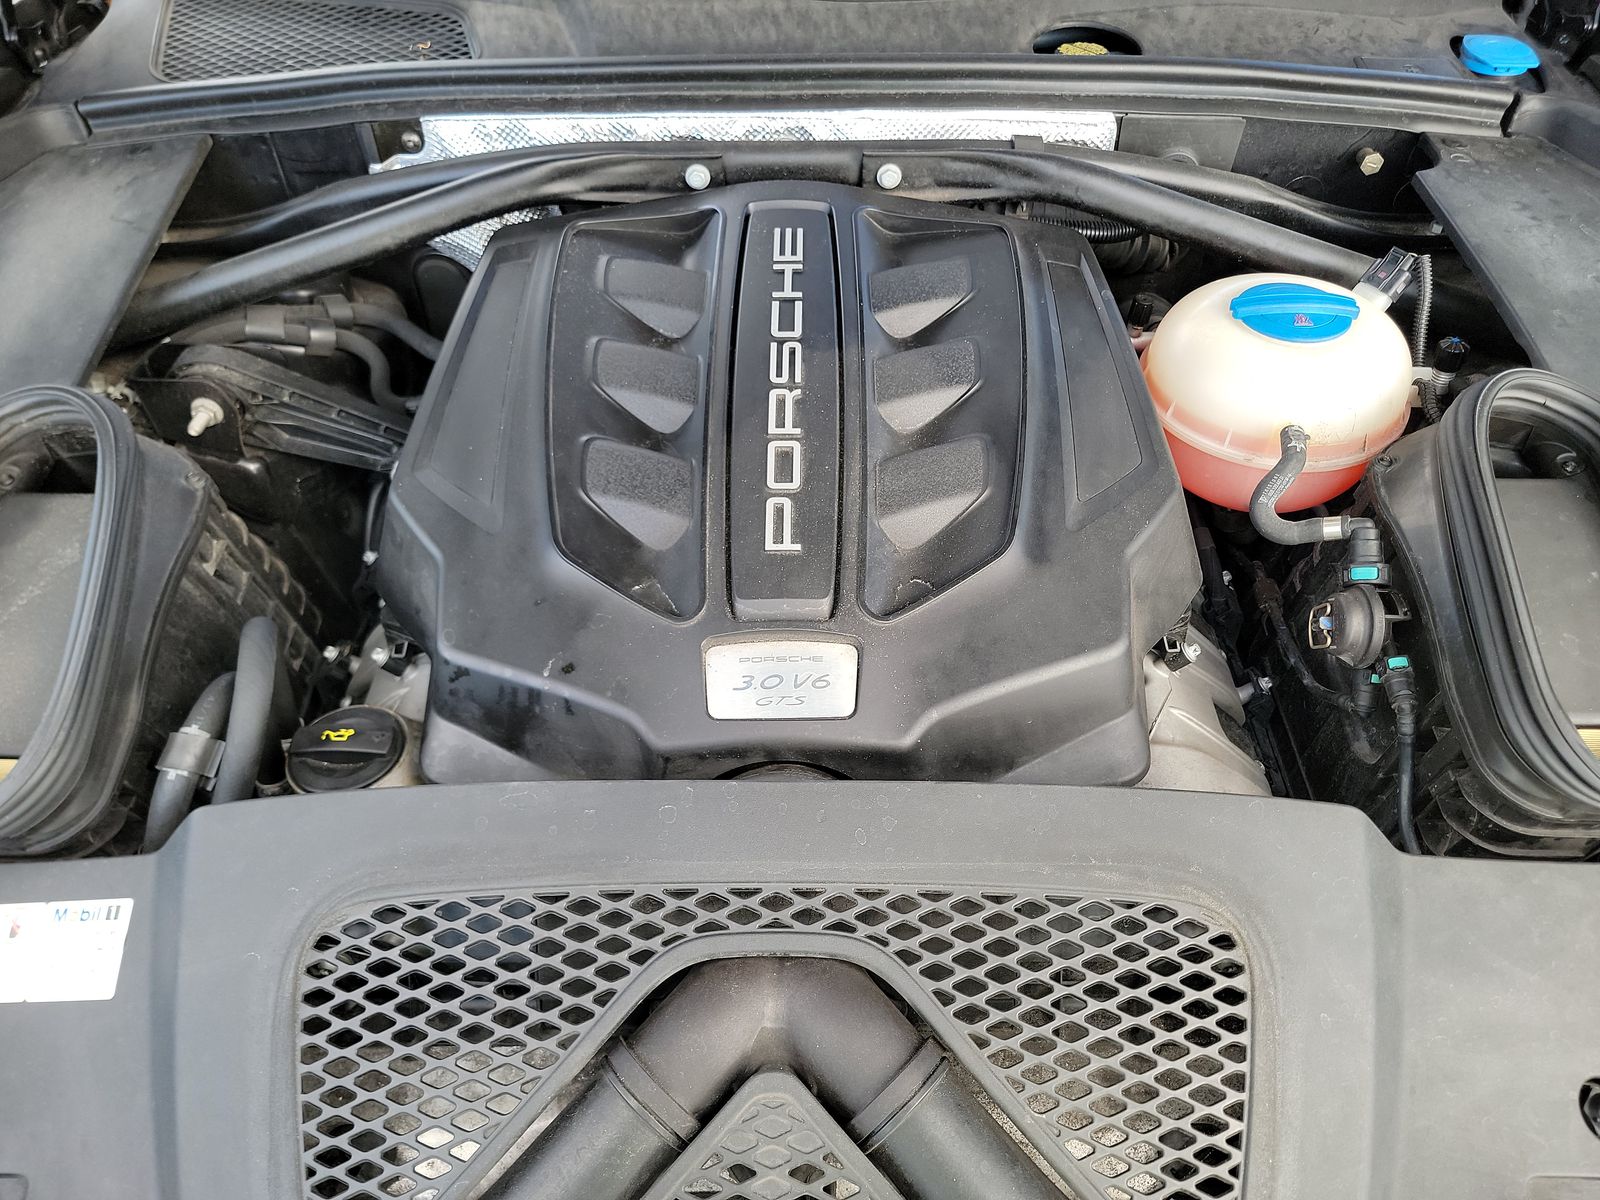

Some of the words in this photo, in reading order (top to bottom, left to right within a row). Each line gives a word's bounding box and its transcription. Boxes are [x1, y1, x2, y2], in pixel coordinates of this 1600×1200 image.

[764, 227, 804, 552] PORSCHE
[738, 655, 824, 663] PORSCHE
[732, 674, 784, 691] 3.0
[793, 673, 831, 689] V6
[755, 695, 807, 706] GTS
[54, 907, 102, 922] Mbil
